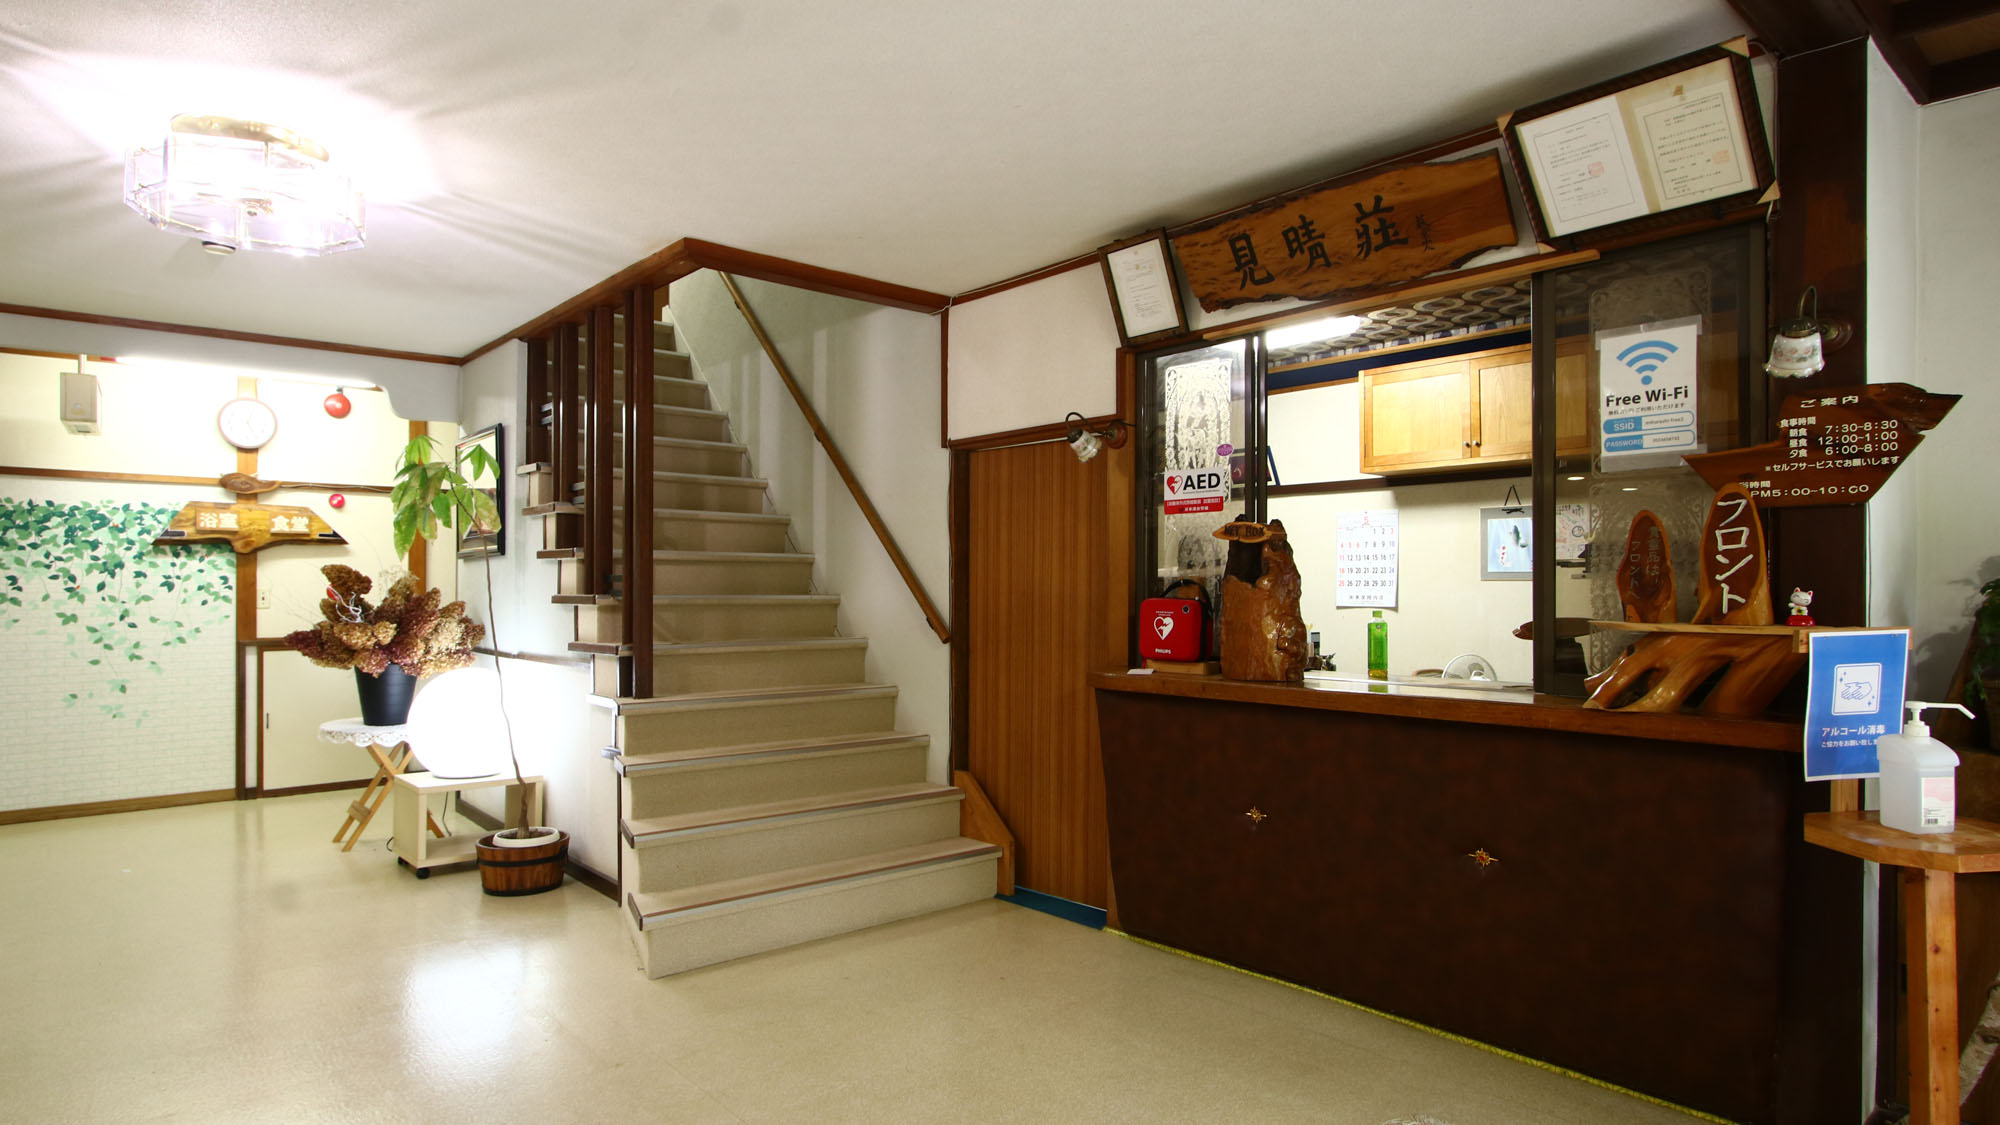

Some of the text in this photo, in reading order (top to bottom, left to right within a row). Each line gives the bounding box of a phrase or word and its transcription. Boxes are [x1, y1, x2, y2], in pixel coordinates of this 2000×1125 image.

[1606, 386, 1688, 407] Free Wi-Fi
[1800, 395, 1859, 408] ご案内
[1613, 422, 1635, 431] SSID
[1780, 416, 1816, 428] 食事時間
[1789, 428, 1808, 438] 朝食
[1605, 439, 1642, 448] PASSWORD
[1789, 438, 1808, 448] 昼食
[1789, 449, 1808, 459] 夕食
[1183, 473, 1220, 490] AED
[199, 512, 309, 533] 浴室 食堂
[1715, 499, 1753, 614] フロント
[1821, 724, 1886, 737] アルコール消毒
